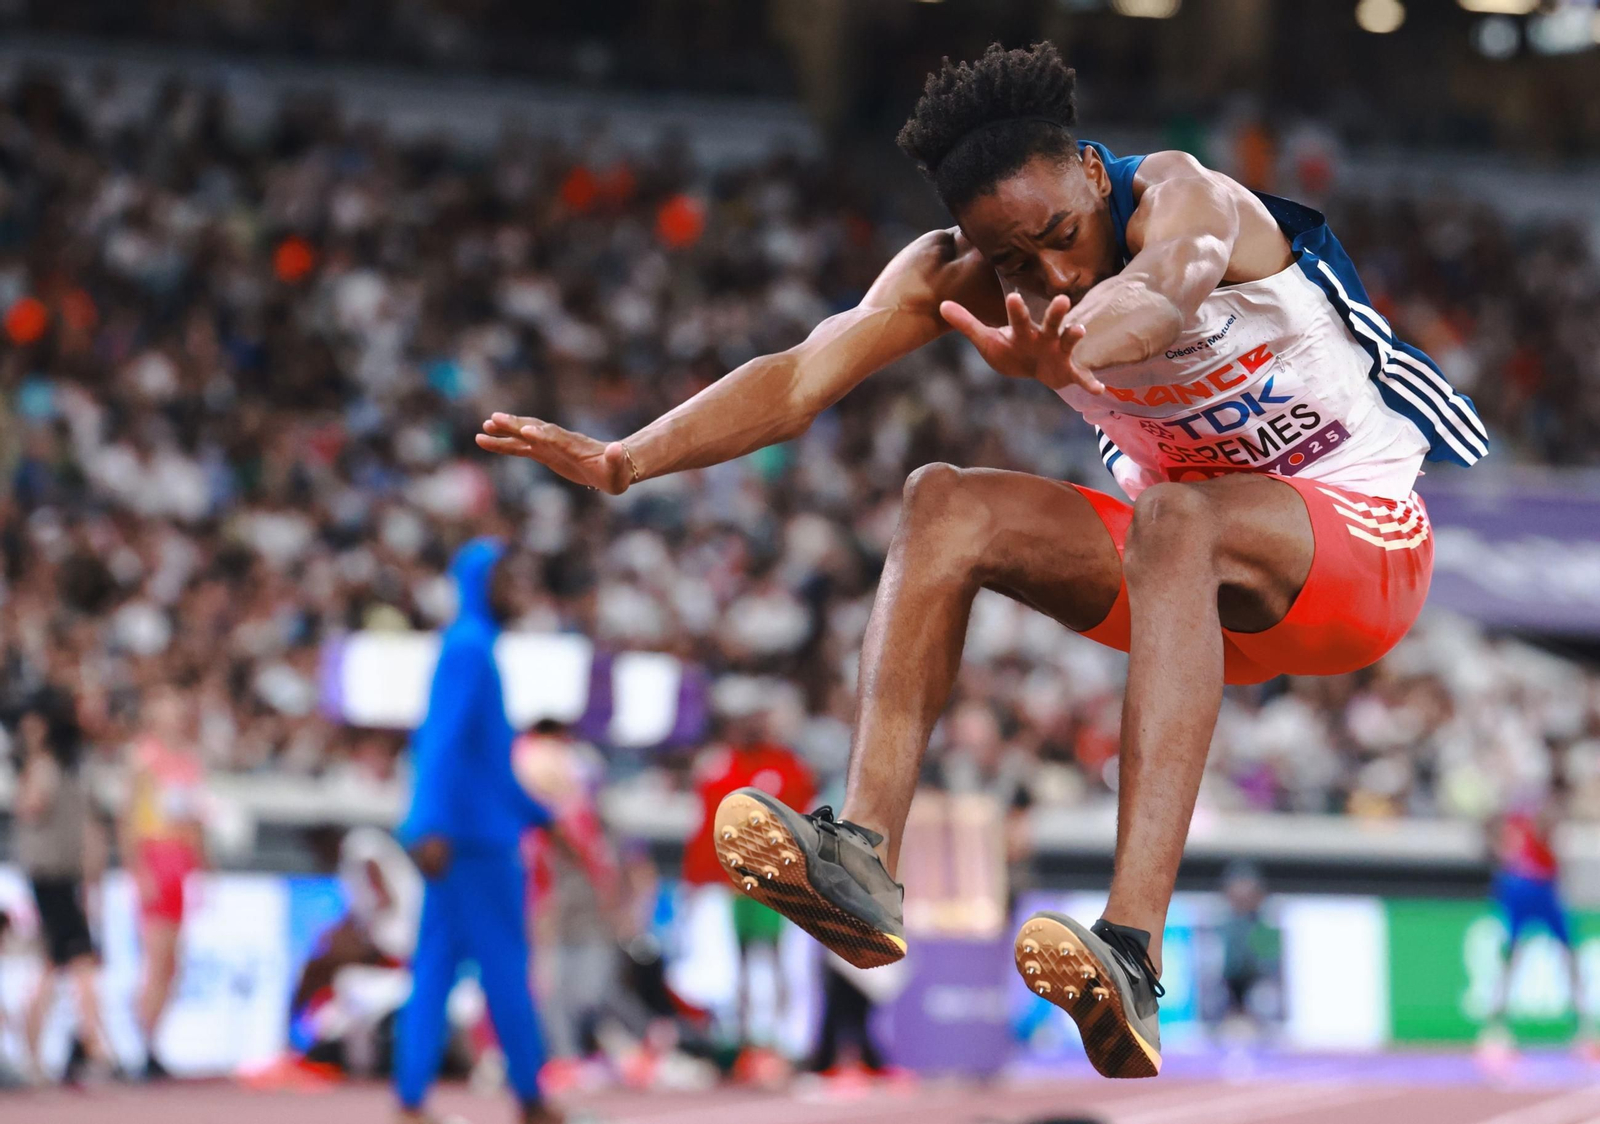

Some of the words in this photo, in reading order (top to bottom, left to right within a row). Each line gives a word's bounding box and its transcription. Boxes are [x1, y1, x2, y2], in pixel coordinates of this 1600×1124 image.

[1165, 345, 1197, 360] Crédit
[1207, 314, 1237, 346] Mutuel
[1104, 343, 1274, 407] RANCE
[1158, 403, 1321, 466] SEREMES
[1164, 374, 1295, 441] TDK
